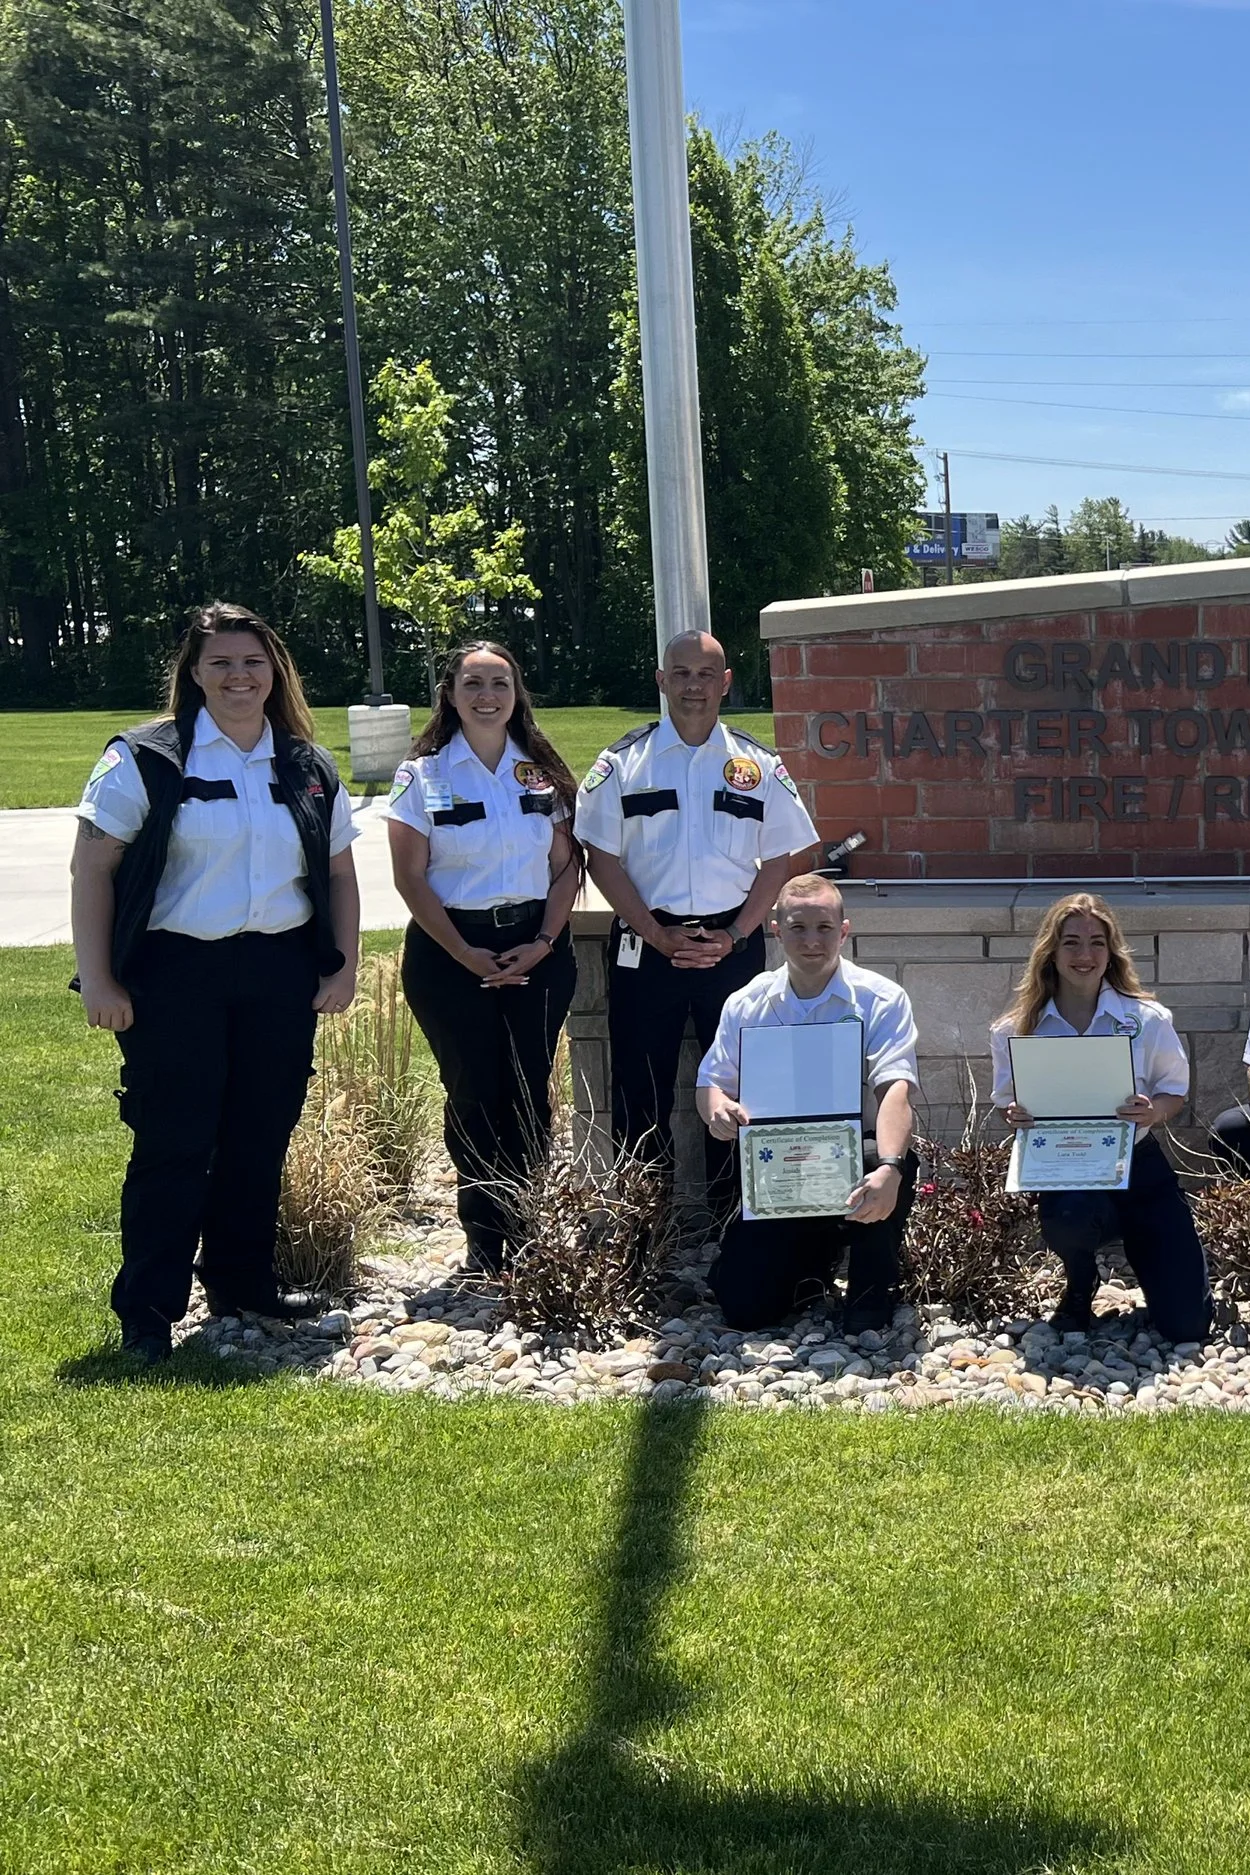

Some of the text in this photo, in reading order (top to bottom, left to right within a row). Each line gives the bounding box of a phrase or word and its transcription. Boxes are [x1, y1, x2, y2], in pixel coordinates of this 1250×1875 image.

[913, 545, 920, 554] &
[923, 543, 959, 556] Delivy
[1006, 642, 1226, 692] GRAND
[808, 709, 1112, 760] CHARTER
[1015, 775, 1151, 824] FIRE
[1165, 774, 1185, 822] /
[761, 1135, 794, 1144] Certificate
[804, 1134, 840, 1143] Completion
